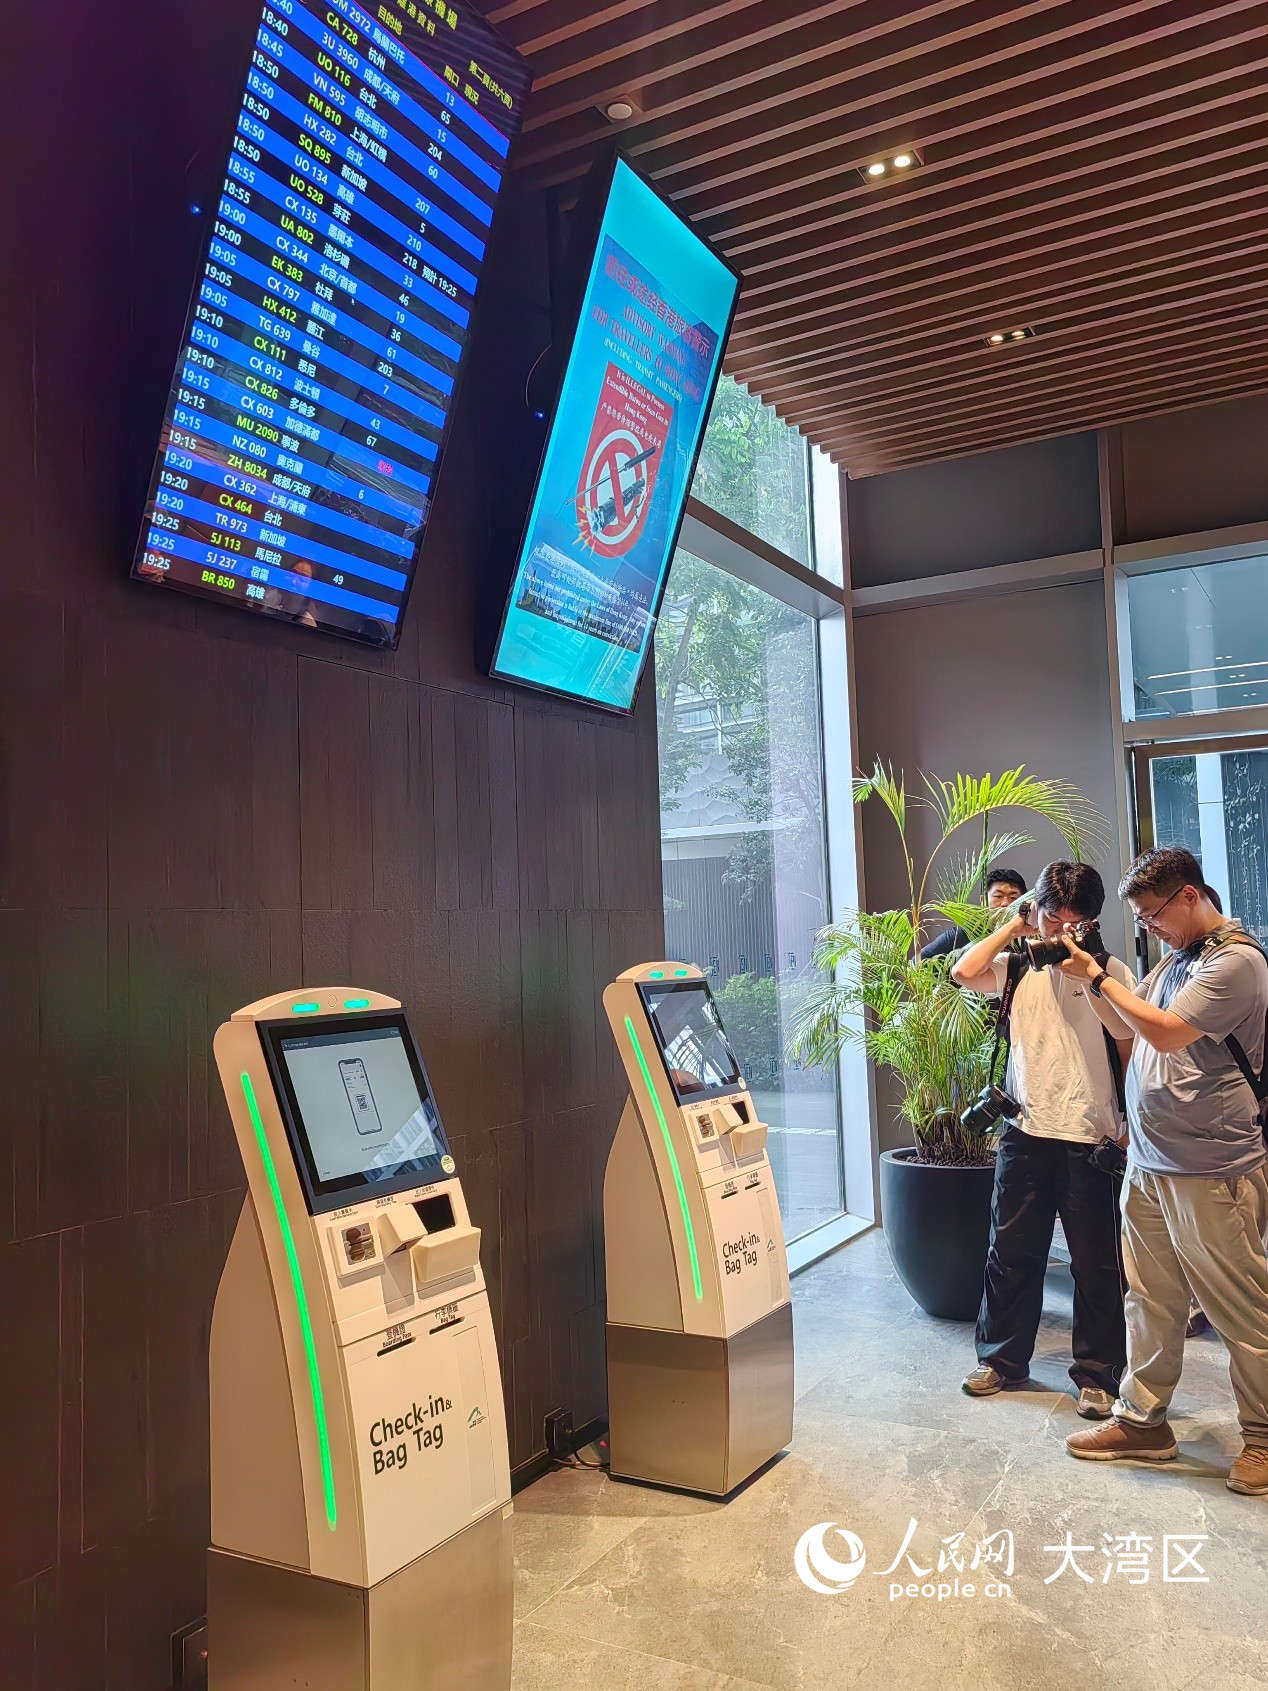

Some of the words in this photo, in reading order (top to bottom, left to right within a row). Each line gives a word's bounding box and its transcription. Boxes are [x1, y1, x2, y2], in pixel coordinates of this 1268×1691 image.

[326, 11, 339, 30] CA
[341, 22, 358, 45] 728
[367, 46, 386, 70] 杭州
[440, 110, 451, 124] 65
[348, 6, 371, 33] 2972
[445, 91, 454, 106] 13
[378, 5, 402, 35] 目的地
[252, 49, 279, 78] 18:50
[307, 92, 323, 112] FM
[324, 105, 341, 125] 810
[256, 28, 283, 57] 18:45
[313, 71, 328, 92] VN
[328, 85, 346, 105] 595
[427, 164, 438, 179] 60
[261, 6, 288, 36] 18:40
[317, 51, 332, 71] UO
[334, 65, 351, 86] 116
[359, 86, 377, 109] 台北
[427, 142, 442, 161] 204
[321, 31, 335, 50] 3U
[336, 43, 358, 69] 3960
[362, 67, 400, 105] 成都/天府
[437, 128, 446, 142] 15
[237, 114, 265, 141] 18:50
[294, 153, 310, 171] UO
[312, 165, 328, 185] 134
[406, 233, 421, 251] 210
[242, 92, 269, 120] 18:50
[298, 133, 313, 153] SQ
[313, 144, 331, 164] 895
[340, 163, 367, 192] 新加坡
[247, 71, 274, 99] 18:50
[303, 113, 318, 132] HX
[318, 125, 336, 145] 282
[345, 145, 364, 167] 台北
[414, 197, 430, 214] 207
[218, 199, 246, 224] 19:00
[275, 235, 290, 252] CX
[290, 244, 308, 263] 344
[395, 310, 405, 324] 19
[223, 178, 250, 204] 18:55
[280, 214, 294, 233] UA
[295, 225, 314, 244] 802
[398, 292, 409, 306] 46
[228, 157, 255, 183] 18:55
[284, 195, 299, 212] CX
[300, 205, 317, 223] 135
[402, 274, 413, 288] 33
[232, 135, 260, 162] 18:50
[289, 173, 305, 192] UO
[305, 185, 324, 205] 528
[402, 252, 418, 269] 218
[438, 277, 457, 297] 19:25
[200, 283, 228, 307] 19:05
[258, 314, 272, 331] TG
[272, 323, 291, 341] 639
[204, 262, 232, 286] 19:05
[261, 295, 278, 313] HX
[278, 305, 297, 323] 412
[376, 360, 393, 377] 203
[209, 241, 237, 266] 19:05
[266, 275, 281, 292] CX
[282, 283, 300, 302] 797
[386, 346, 396, 359] 61
[213, 220, 241, 245] 19:00
[271, 254, 285, 271] EK
[284, 263, 303, 282] 383
[390, 327, 401, 342] 36
[191, 325, 219, 348] 19:10
[248, 355, 264, 371] CX
[263, 362, 282, 381] 812
[369, 417, 381, 429] 43
[195, 304, 223, 327] 19:10
[253, 335, 269, 352] CX
[269, 343, 286, 361] 111
[173, 408, 201, 430] 19:15
[231, 433, 248, 450] NZ
[248, 441, 266, 458] 080
[177, 387, 206, 409] 19:15
[235, 413, 255, 431] MU
[254, 423, 279, 442] 2090
[181, 367, 210, 389] 19:15
[239, 394, 255, 411] CX
[255, 402, 274, 419] 603
[186, 346, 214, 369] 19:10
[244, 375, 260, 391] CX
[259, 382, 278, 400] 826
[365, 434, 377, 446] 67
[159, 470, 188, 490] 19:20
[218, 493, 233, 507] CX
[233, 499, 252, 514] 464
[263, 509, 282, 526] 台北
[164, 449, 192, 470] 19:20
[223, 473, 238, 488] CX
[238, 479, 257, 496] 362
[168, 429, 197, 450] 19:15
[226, 453, 243, 469] ZH
[243, 460, 267, 479] 8034
[271, 473, 311, 498] 成都/天府
[147, 531, 175, 550] 19:25
[217, 555, 237, 569] 237
[151, 511, 179, 530] 19:25
[224, 536, 241, 551] 113
[332, 573, 344, 585] 49
[155, 491, 183, 510] 19:20
[215, 512, 228, 526] TR
[229, 517, 247, 532] 973
[258, 527, 287, 548] 新加坡
[142, 551, 170, 570] 19:25
[201, 569, 216, 584] BR
[216, 574, 235, 589] 850
[724, 1253, 742, 1277] Bag
[743, 1246, 758, 1267] Tag
[373, 1440, 408, 1476] Bag
[412, 1421, 444, 1453] Tag
